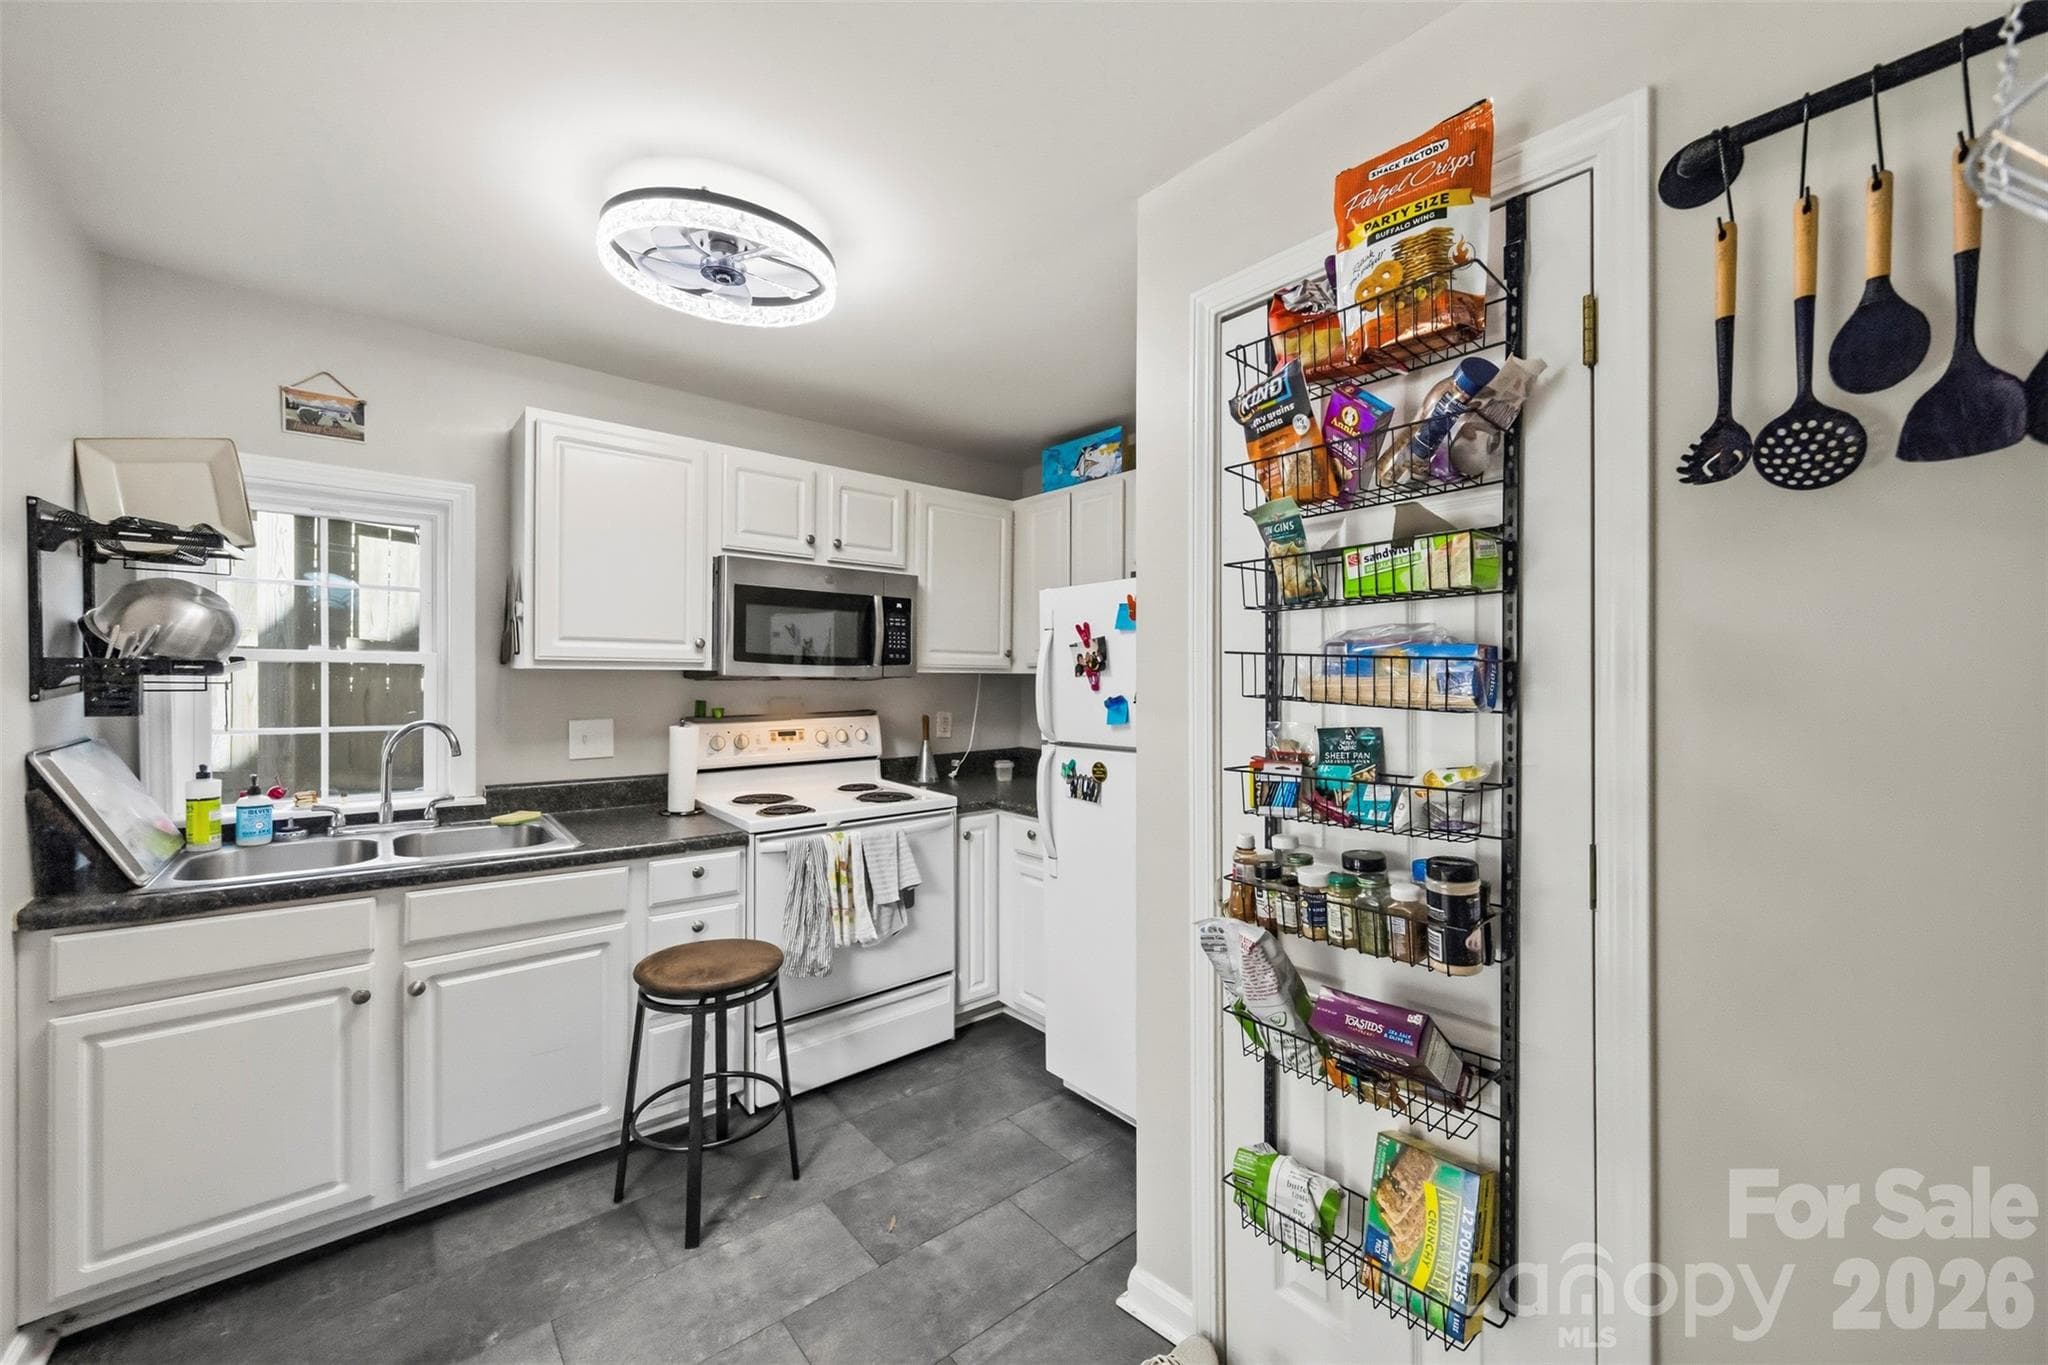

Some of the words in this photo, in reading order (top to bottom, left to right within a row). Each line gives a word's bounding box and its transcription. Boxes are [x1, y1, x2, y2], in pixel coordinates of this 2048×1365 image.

[1371, 160, 1400, 178] SNACK
[1403, 142, 1446, 166] FACTORY
[1344, 172, 1412, 219] Pretzel
[1410, 151, 1475, 187] Crisps
[1364, 206, 1410, 233] PARTY
[1414, 192, 1450, 211] SIZE
[1375, 220, 1411, 240] BUFFALO
[1413, 211, 1436, 225] WING
[1267, 402, 1295, 421] grains
[1324, 751, 1350, 760] SHEET
[1353, 751, 1371, 760] PAN
[1344, 1013, 1385, 1034] TOASTEDS
[1438, 1192, 1458, 1250] NATURE
[1463, 1206, 1475, 1227] 12
[1422, 1210, 1437, 1268] CRUNCHY
[1427, 1250, 1451, 1299] VALLEY
[1454, 1228, 1473, 1305] POUCHES
